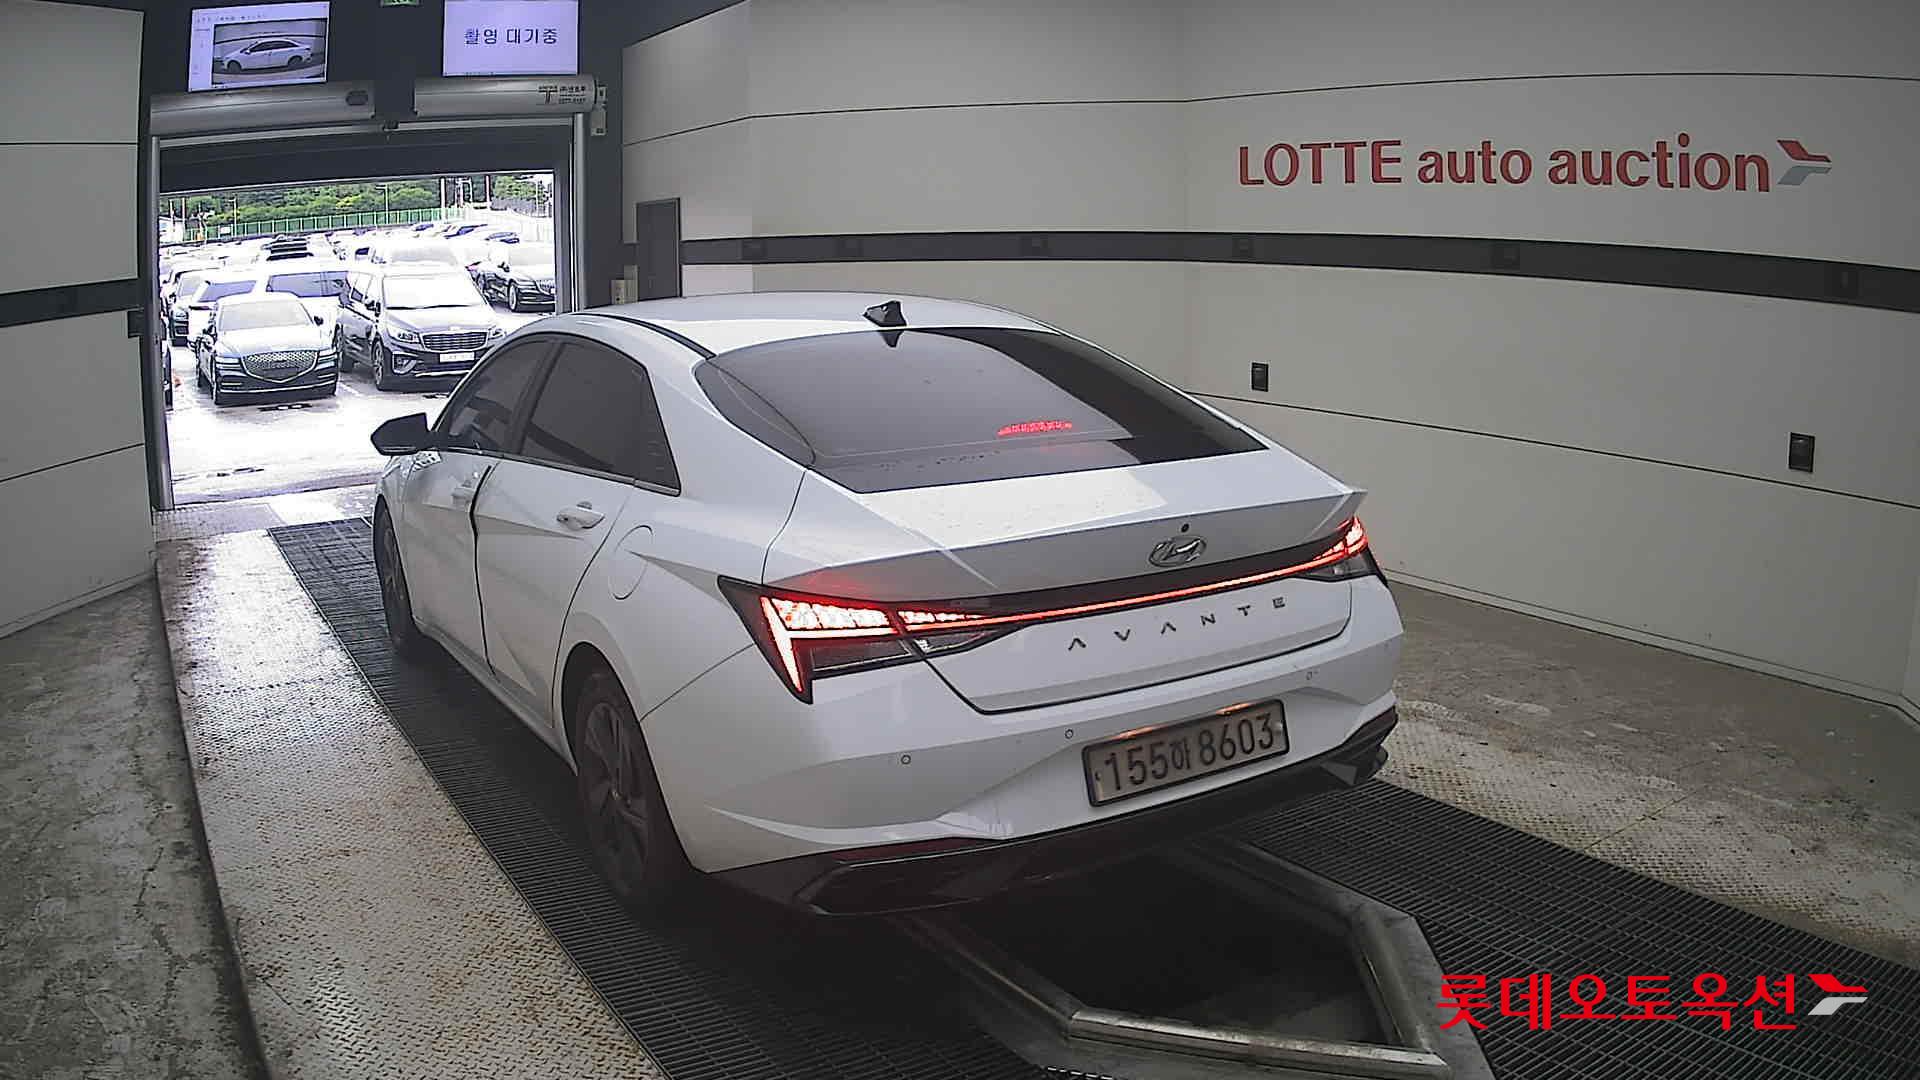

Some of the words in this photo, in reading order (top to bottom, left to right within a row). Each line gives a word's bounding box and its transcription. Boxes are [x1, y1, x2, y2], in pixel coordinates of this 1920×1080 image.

[506, 28, 557, 45] 대기중
[1239, 140, 1401, 187] LOTTE
[1417, 140, 1533, 185] auto
[1548, 133, 1771, 193] auction
[1068, 597, 1286, 651] AVANTE
[1199, 712, 1274, 766] 8603
